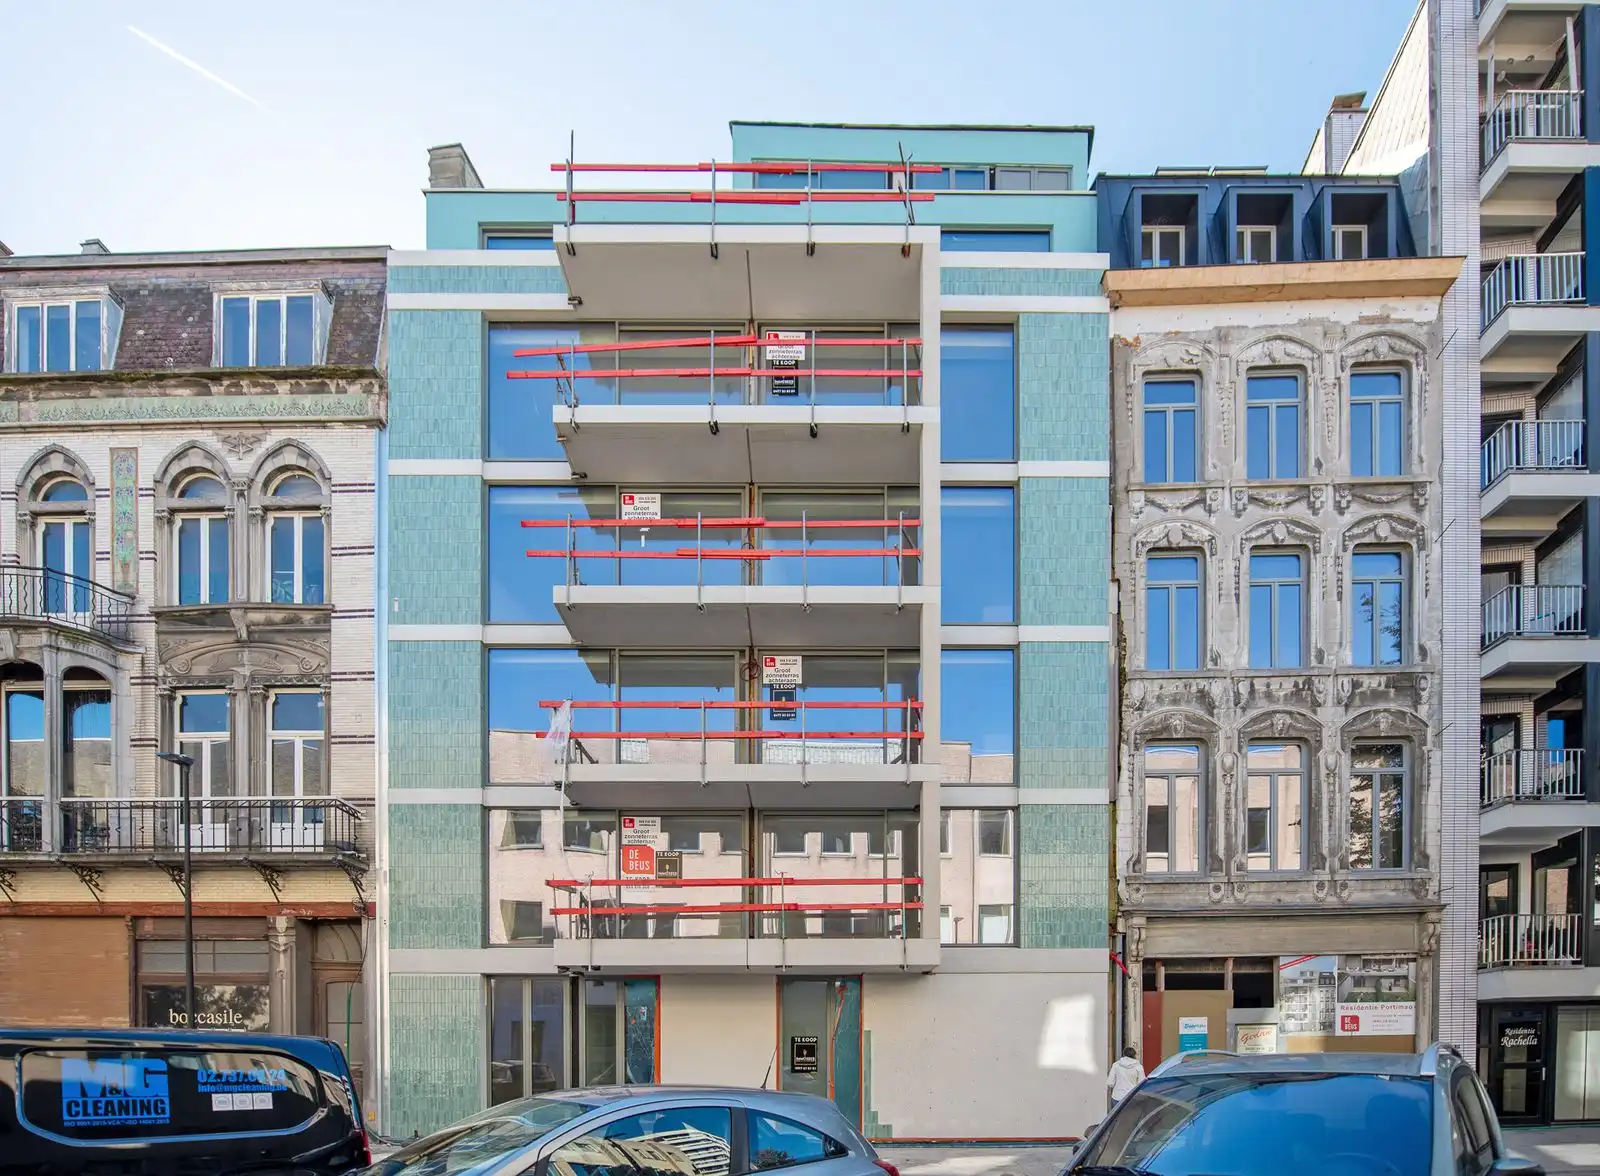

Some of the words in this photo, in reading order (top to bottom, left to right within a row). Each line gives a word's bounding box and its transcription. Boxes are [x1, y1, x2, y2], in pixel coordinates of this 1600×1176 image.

[628, 849, 639, 860] DE
[628, 860, 650, 871] BEUS
[168, 1009, 243, 1024] bocasile
[1505, 1027, 1536, 1035] Residentie
[1501, 1035, 1538, 1047] Rachella
[65, 1099, 168, 1118] CLEANING
